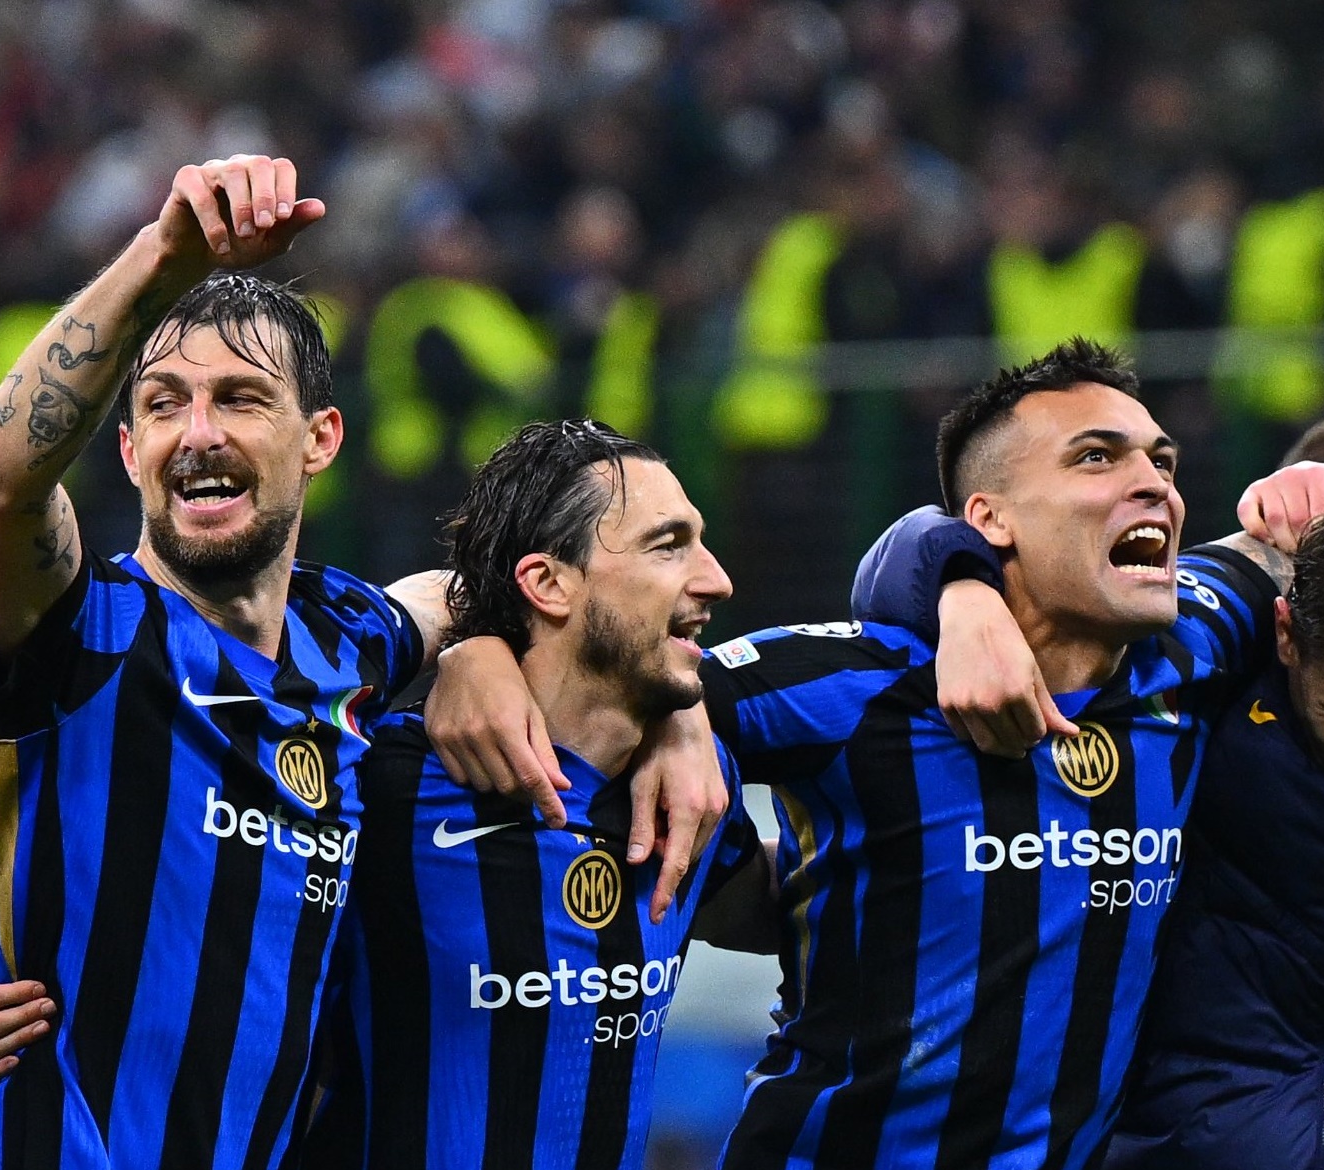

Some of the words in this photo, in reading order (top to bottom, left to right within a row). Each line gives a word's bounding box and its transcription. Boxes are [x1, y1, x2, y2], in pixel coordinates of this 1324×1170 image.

[203, 786, 359, 866] betsso
[964, 819, 1183, 872] betsson
[295, 873, 349, 913] .spo
[1081, 870, 1177, 915] .sport
[469, 954, 682, 1010] betsson
